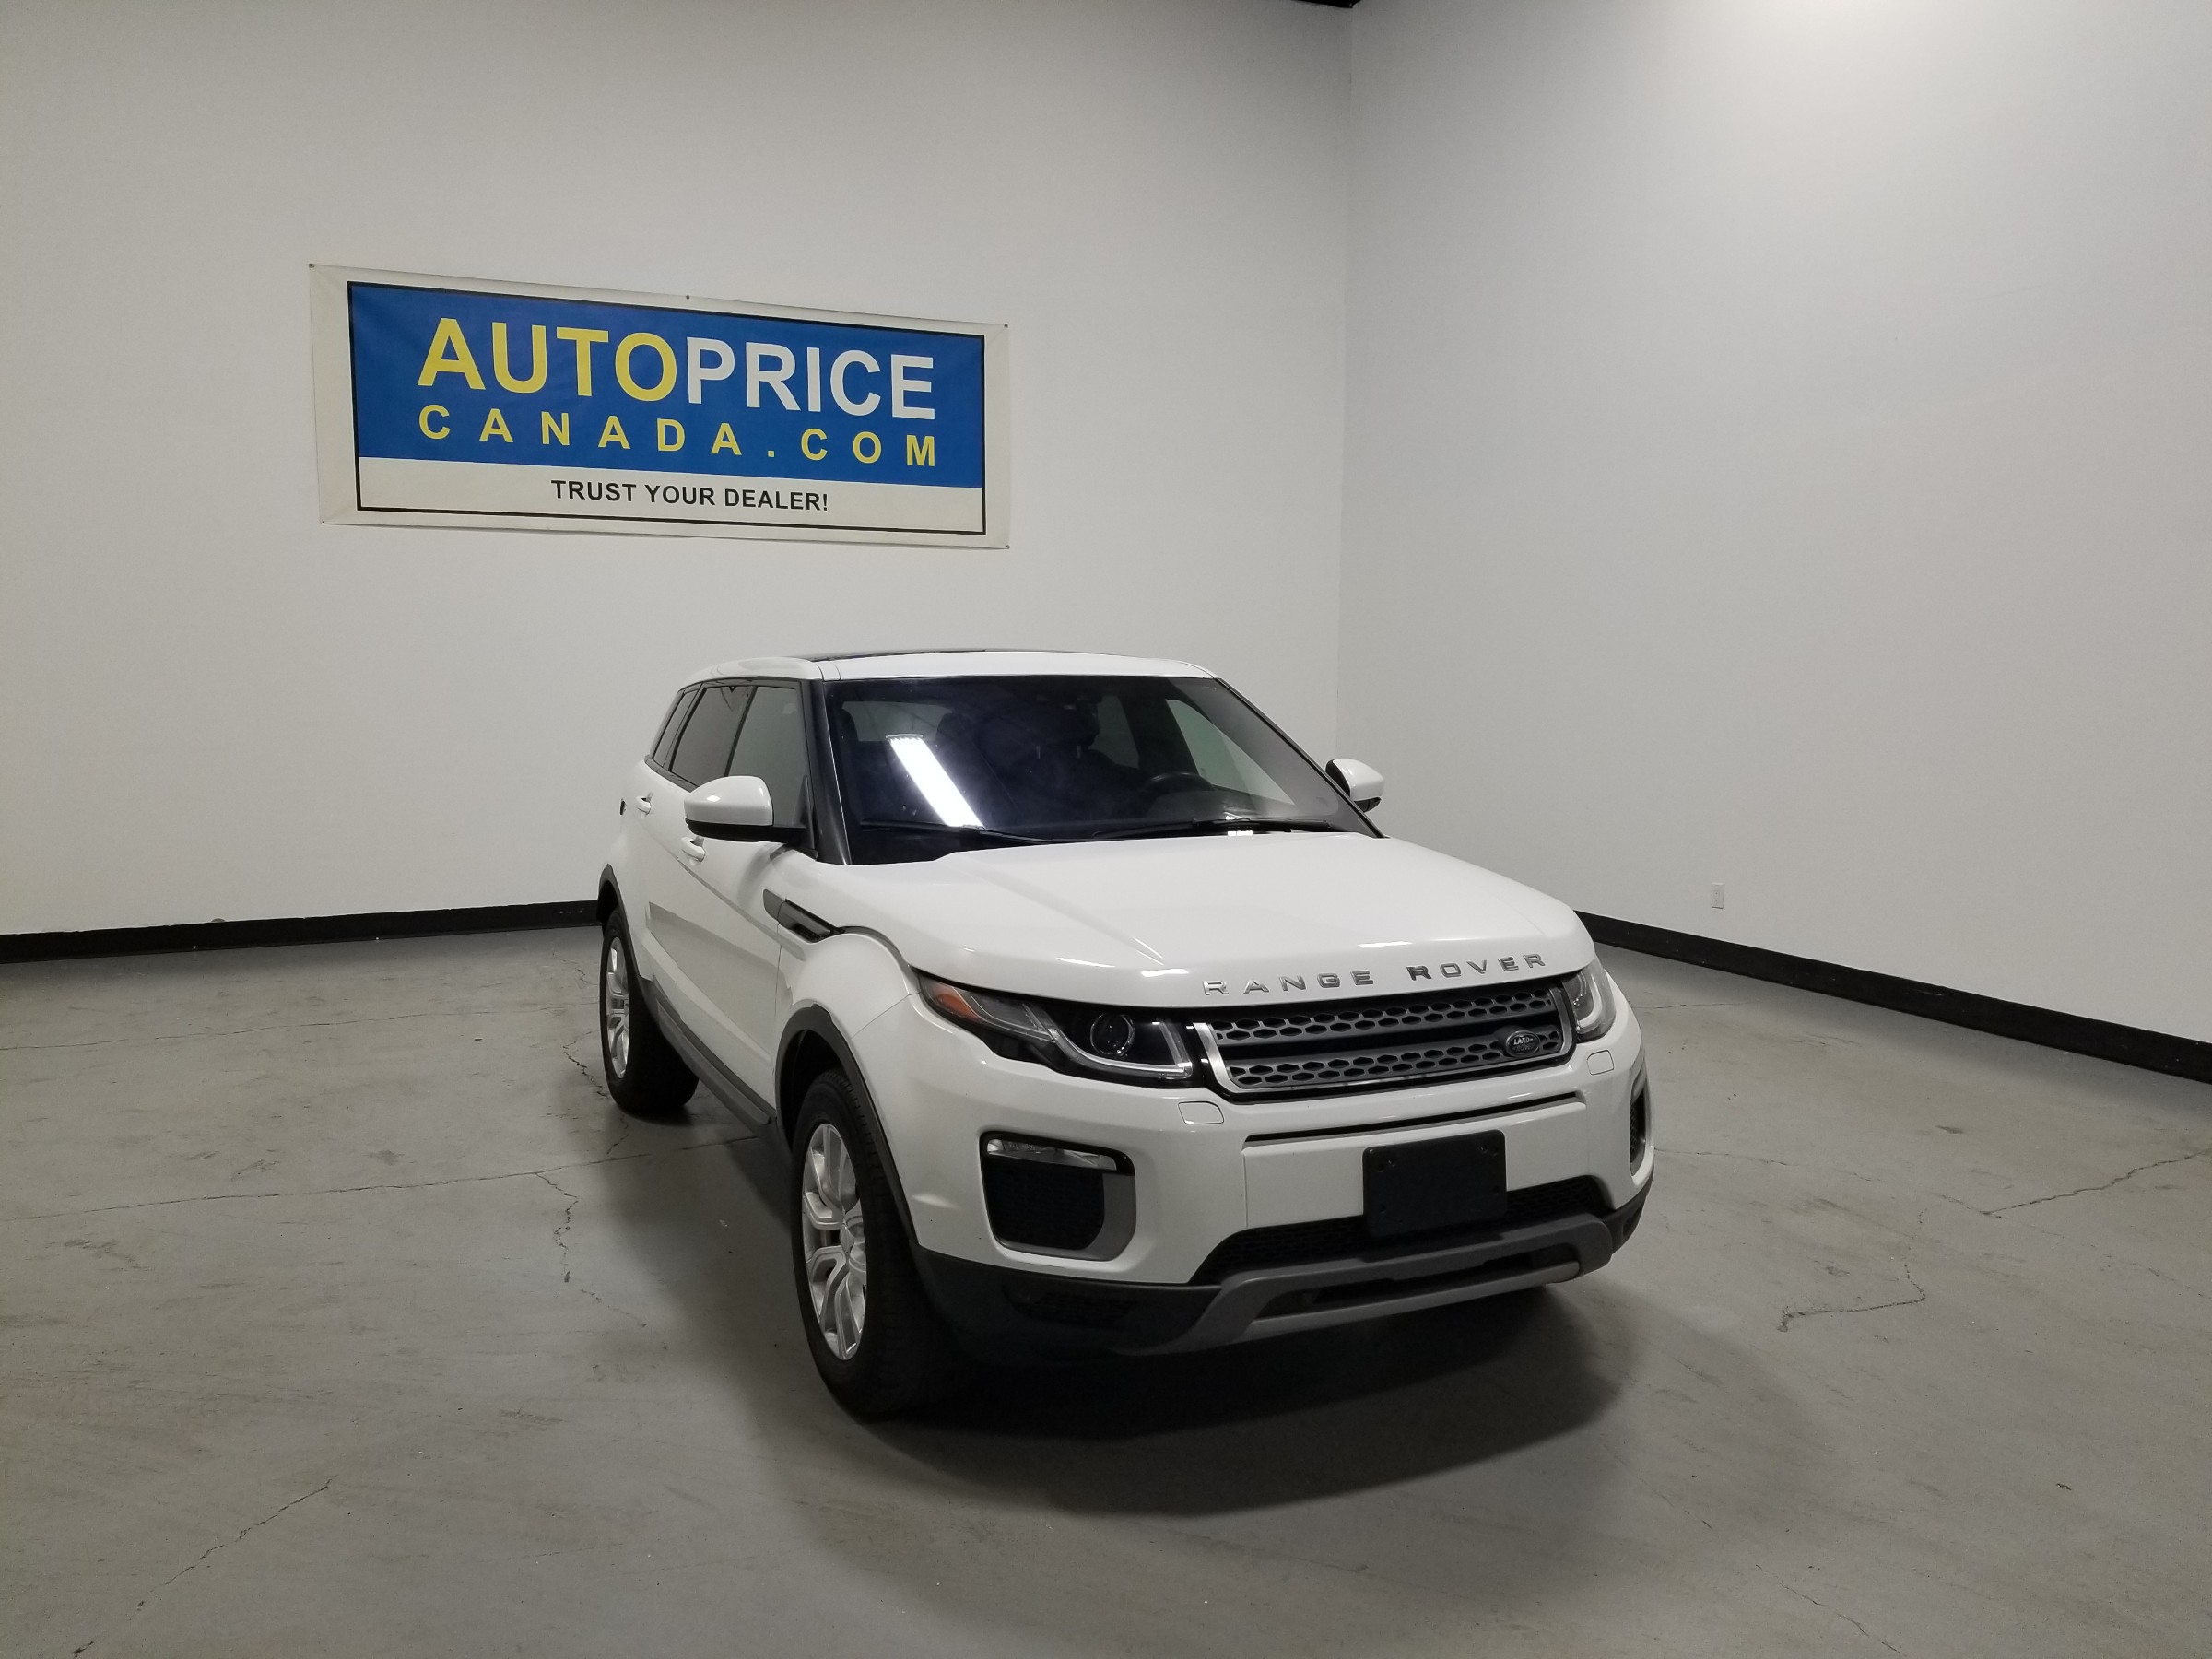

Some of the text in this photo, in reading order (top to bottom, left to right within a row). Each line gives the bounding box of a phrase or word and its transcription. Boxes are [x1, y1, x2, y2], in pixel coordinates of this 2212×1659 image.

[418, 318, 935, 420] AUTOPRICE
[418, 405, 935, 466] CANADA.COM
[551, 480, 830, 512] TRUST YOUR DEALER!
[1203, 953, 1546, 995] RANGE ROVER
